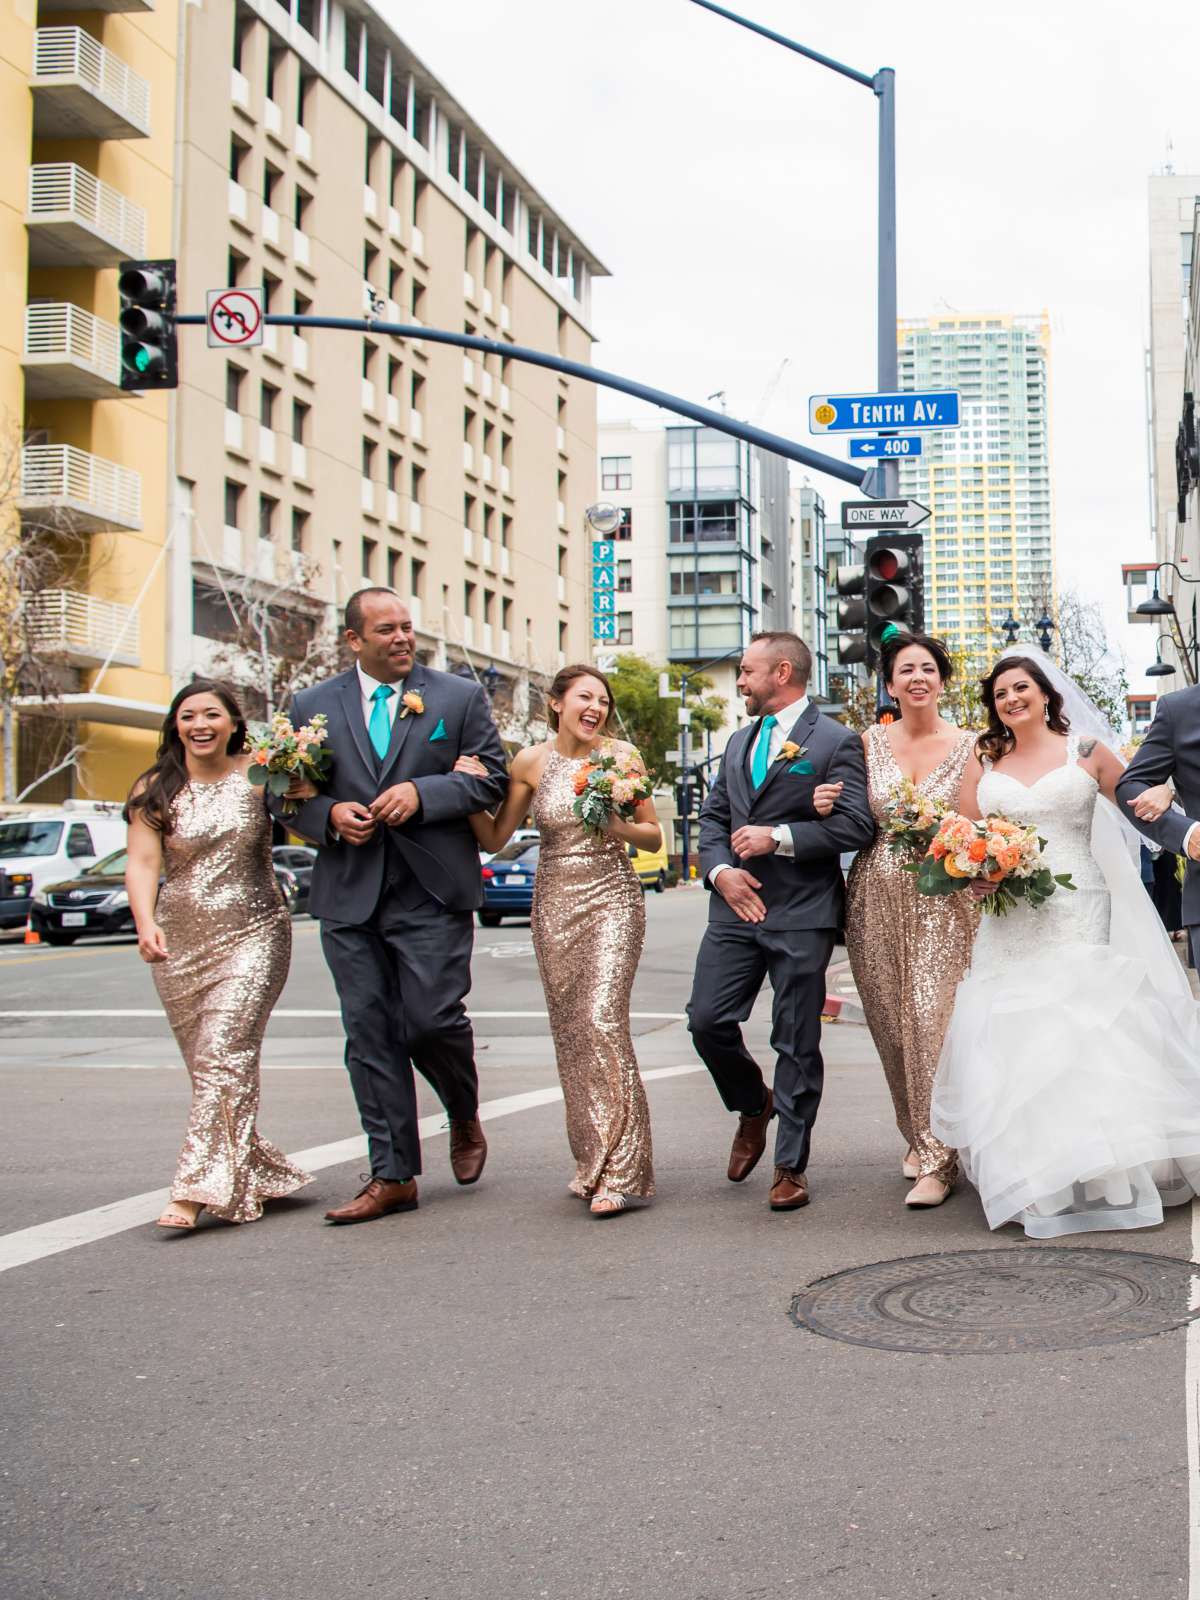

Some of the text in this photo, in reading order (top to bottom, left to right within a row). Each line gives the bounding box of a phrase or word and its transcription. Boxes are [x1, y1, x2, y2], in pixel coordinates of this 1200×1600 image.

[850, 402, 905, 424] TENTH
[884, 440, 910, 454] 400
[851, 509, 905, 521] ONE WAY
[598, 545, 611, 635] PARK
